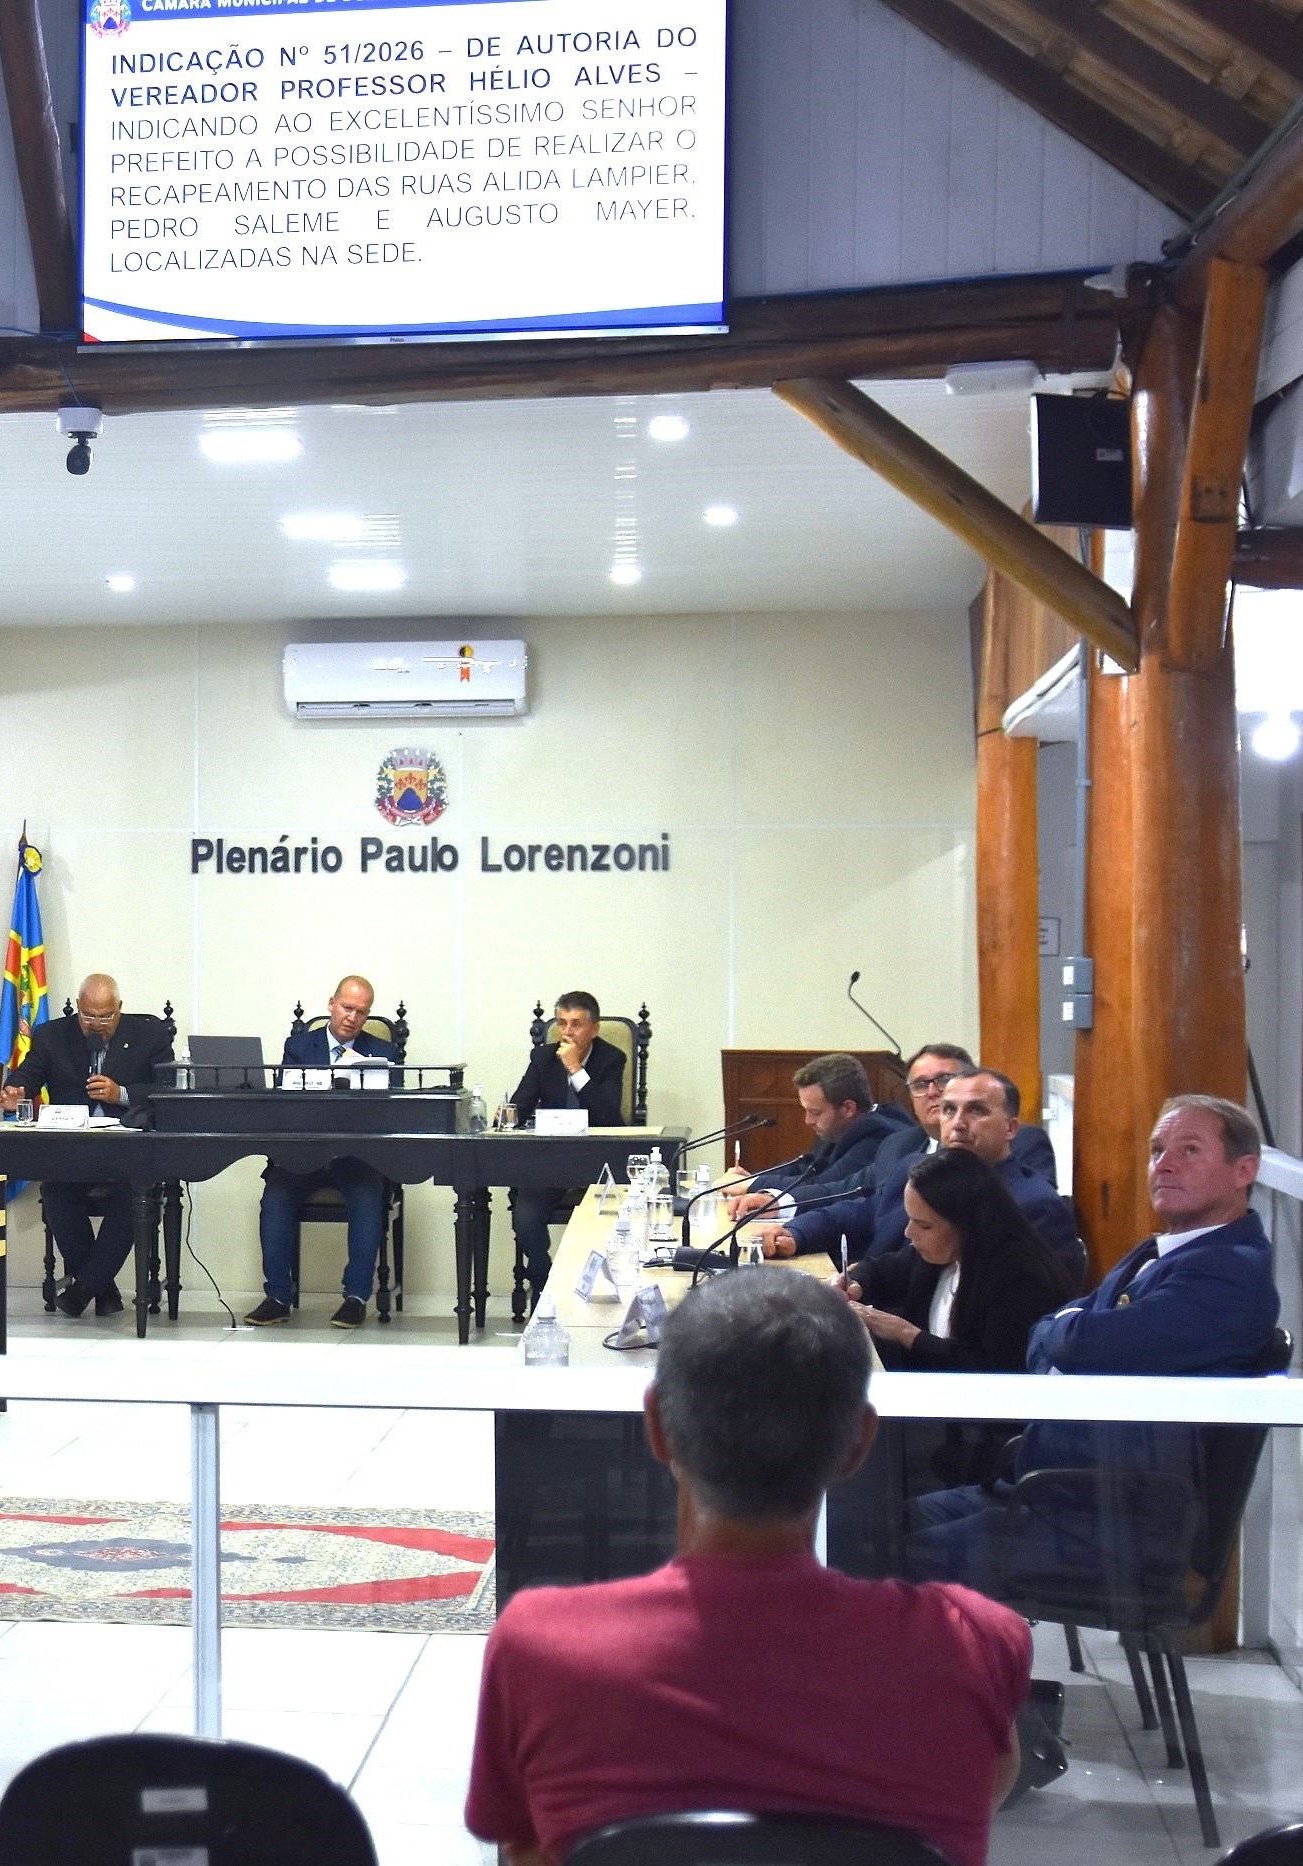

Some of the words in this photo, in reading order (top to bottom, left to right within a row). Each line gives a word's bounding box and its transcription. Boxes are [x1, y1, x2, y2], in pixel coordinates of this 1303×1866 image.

[112, 43, 265, 76] INDICAÇÃO
[323, 40, 424, 65] 51/2026
[467, 36, 501, 58] DE
[516, 29, 641, 56] AUTORIA
[657, 26, 697, 48] DO
[110, 81, 258, 108] VEREADOR
[281, 73, 446, 100] PROFESSOR
[470, 64, 551, 92] HÉLIO
[574, 62, 661, 87] ALVES
[111, 114, 258, 141] INDICANDO
[274, 112, 312, 134] AO
[330, 99, 564, 132] EXCELENTÍSSIMO
[582, 95, 696, 120] SENHOR
[111, 149, 234, 174] PREFEITO
[245, 148, 263, 169] A
[274, 138, 475, 167] POSSIBILIDADE
[488, 136, 522, 158] DE
[535, 130, 663, 156] REALIZAR
[676, 129, 696, 150] O
[111, 178, 327, 207] RECAPEAMENTO
[338, 175, 390, 198] DAS
[401, 172, 472, 196] RUAS
[482, 169, 561, 192] ALIDA
[111, 216, 199, 240] PEDRO
[234, 211, 340, 236] SALEME
[377, 209, 390, 230] E
[426, 202, 559, 228] AUGUSTO
[110, 246, 292, 273] LOCALIZADAS
[302, 245, 338, 266] NA
[347, 242, 422, 265] SEDE.
[191, 834, 343, 874] Plenário
[360, 836, 459, 873] Paulo
[481, 832, 669, 873] Lorenzoni
